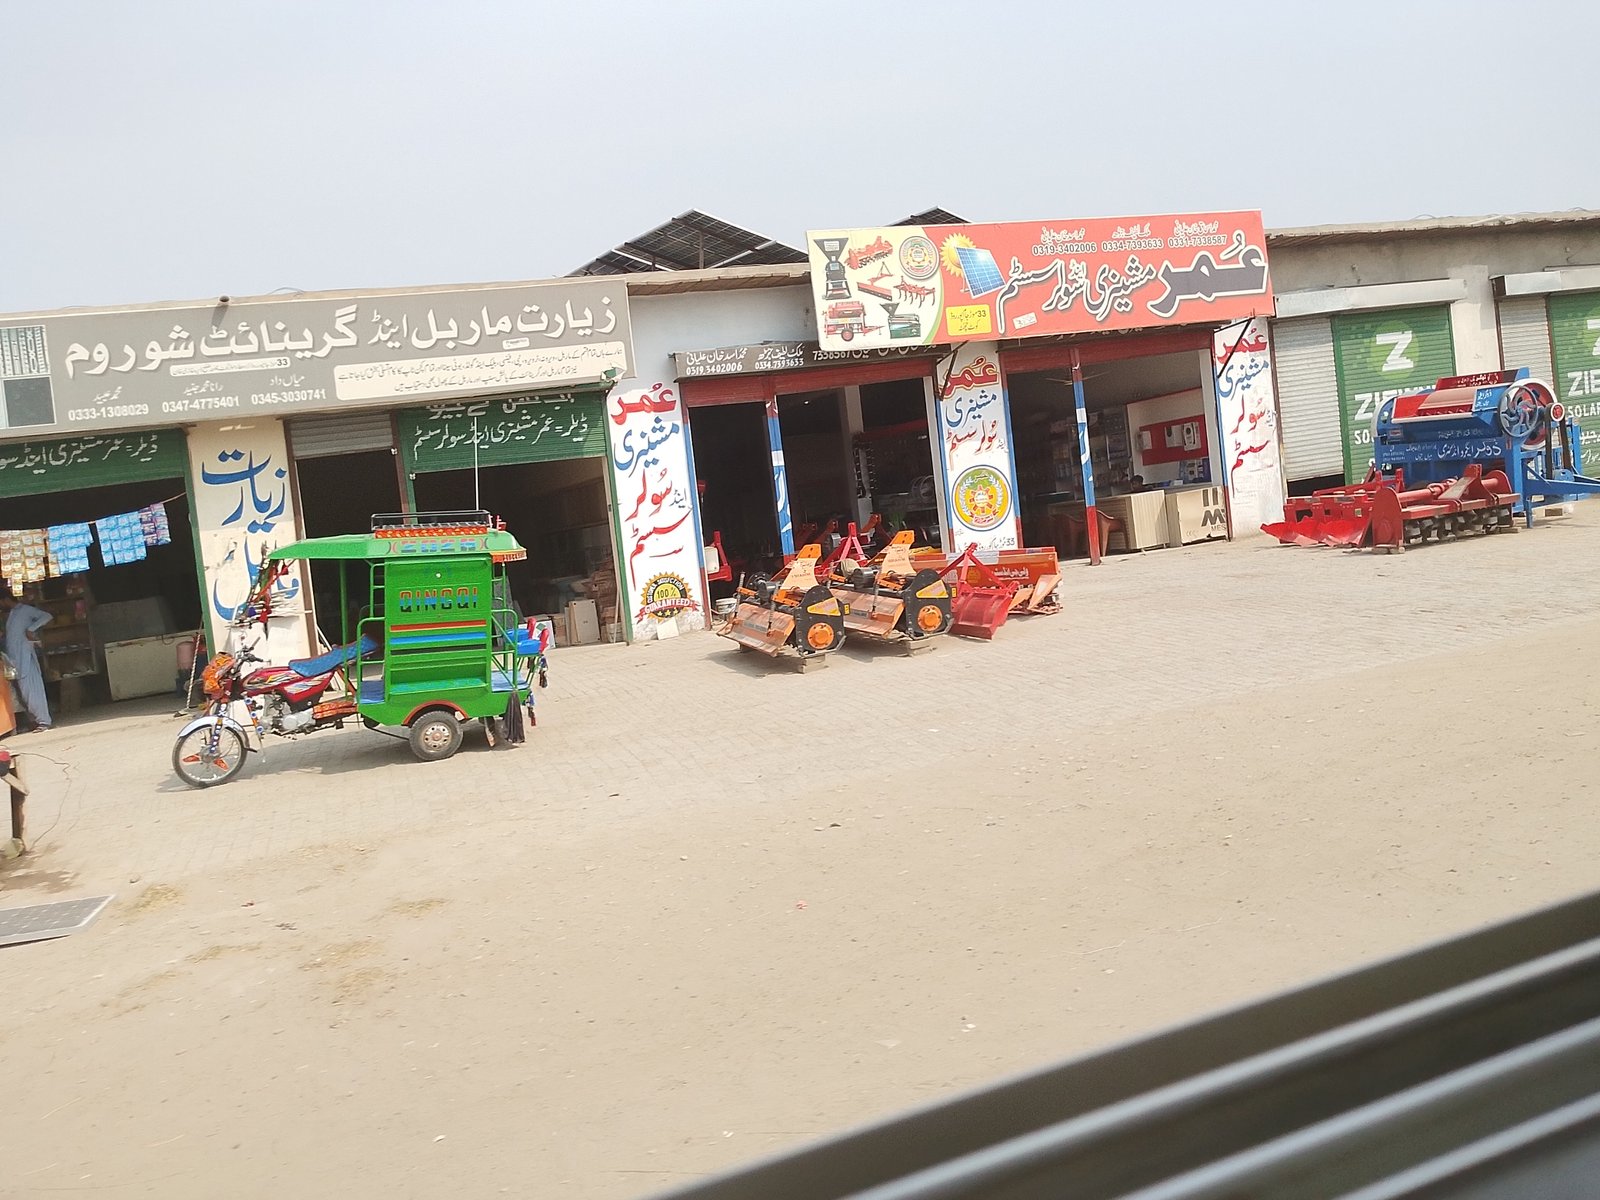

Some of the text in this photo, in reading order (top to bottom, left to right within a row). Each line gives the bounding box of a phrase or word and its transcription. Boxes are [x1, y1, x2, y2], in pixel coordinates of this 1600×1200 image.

[1033, 242, 1097, 256] 0319-3402006
[1102, 239, 1164, 252] 0334-7393633
[1168, 235, 1227, 248] 0331-7338587
[997, 256, 1060, 334] سسٹم
[1083, 254, 1156, 320] مشینری
[367, 309, 408, 348] اینڈ
[411, 306, 513, 349] ماربل
[516, 296, 617, 338] زیارت
[977, 310, 987, 318] 33
[200, 303, 358, 359] گرینائٹ
[276, 358, 288, 367] 33
[1375, 330, 1414, 372] Z
[1218, 358, 1270, 401] مشینری
[68, 403, 149, 421] 0333-1308029
[162, 396, 239, 413] 0347-4775401
[251, 389, 327, 405] 0345-3030741
[945, 389, 997, 428] مشینری
[413, 425, 441, 461] سسٹم
[434, 424, 467, 450] سولر
[490, 410, 538, 444] مشینری
[560, 412, 588, 442] ڈیلر
[15, 443, 47, 475] اینڈ
[50, 436, 103, 467] مشینری
[130, 435, 158, 462] ڈیلر
[614, 416, 680, 478] مشینری
[201, 449, 287, 534] زیارت
[400, 586, 478, 613] QINGQI
